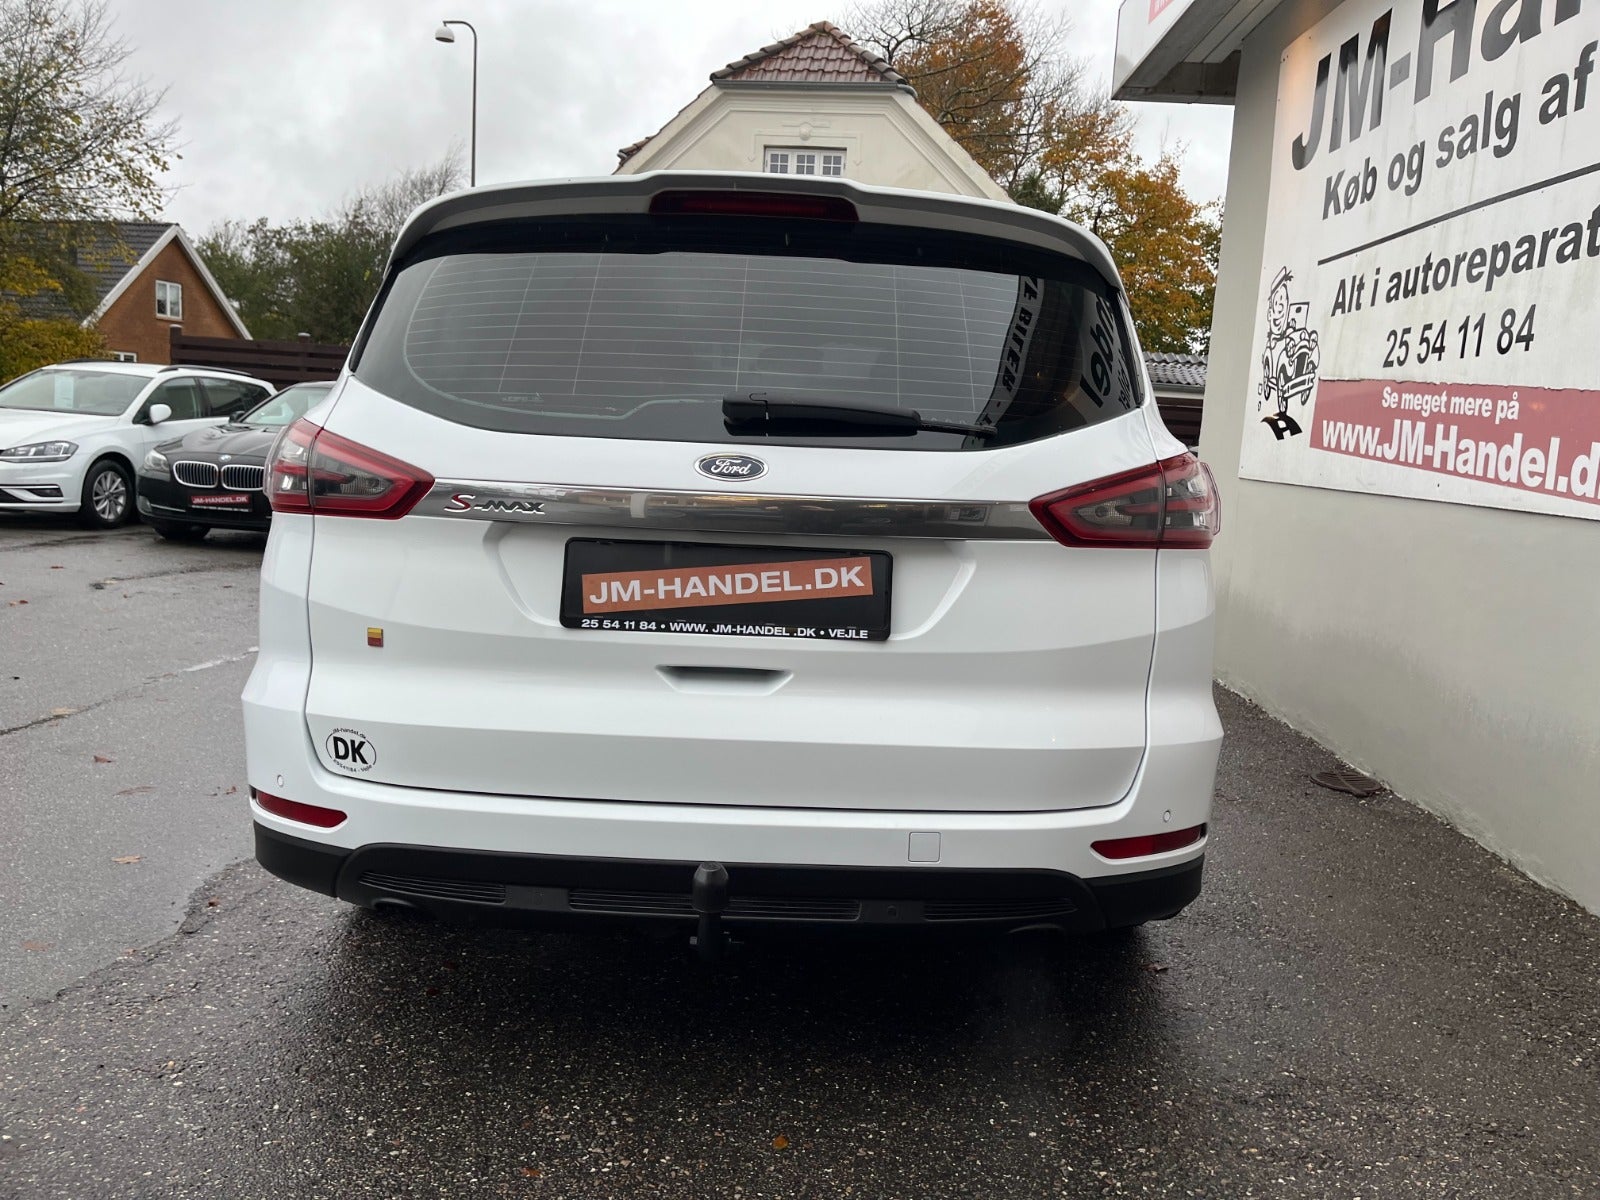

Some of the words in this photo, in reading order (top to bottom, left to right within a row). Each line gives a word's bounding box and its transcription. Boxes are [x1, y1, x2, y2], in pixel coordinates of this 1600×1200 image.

[1322, 157, 1377, 220] Køb
[1387, 140, 1425, 197] og
[1435, 90, 1521, 169] salg
[1539, 40, 1599, 125] af
[1330, 277, 1365, 317] Alt
[1370, 267, 1381, 307] i
[1382, 327, 1411, 368] 25
[1417, 319, 1447, 364] 54
[1458, 312, 1486, 359] 11
[1497, 304, 1536, 355] 84
[1381, 385, 1398, 409] Se
[1401, 390, 1447, 417] meget
[1450, 395, 1492, 417] mere
[1495, 391, 1520, 425] på
[710, 457, 752, 475] Ford
[1322, 418, 1600, 499] www.JM-Handel.d
[444, 493, 546, 515] S-MAX
[589, 565, 865, 605] JM-HANDEL.DK
[581, 618, 599, 628] 25
[602, 619, 620, 629] 54
[623, 620, 636, 629] 11
[639, 620, 657, 630] 84
[828, 628, 869, 639] VEJLE
[333, 736, 369, 765] DK
